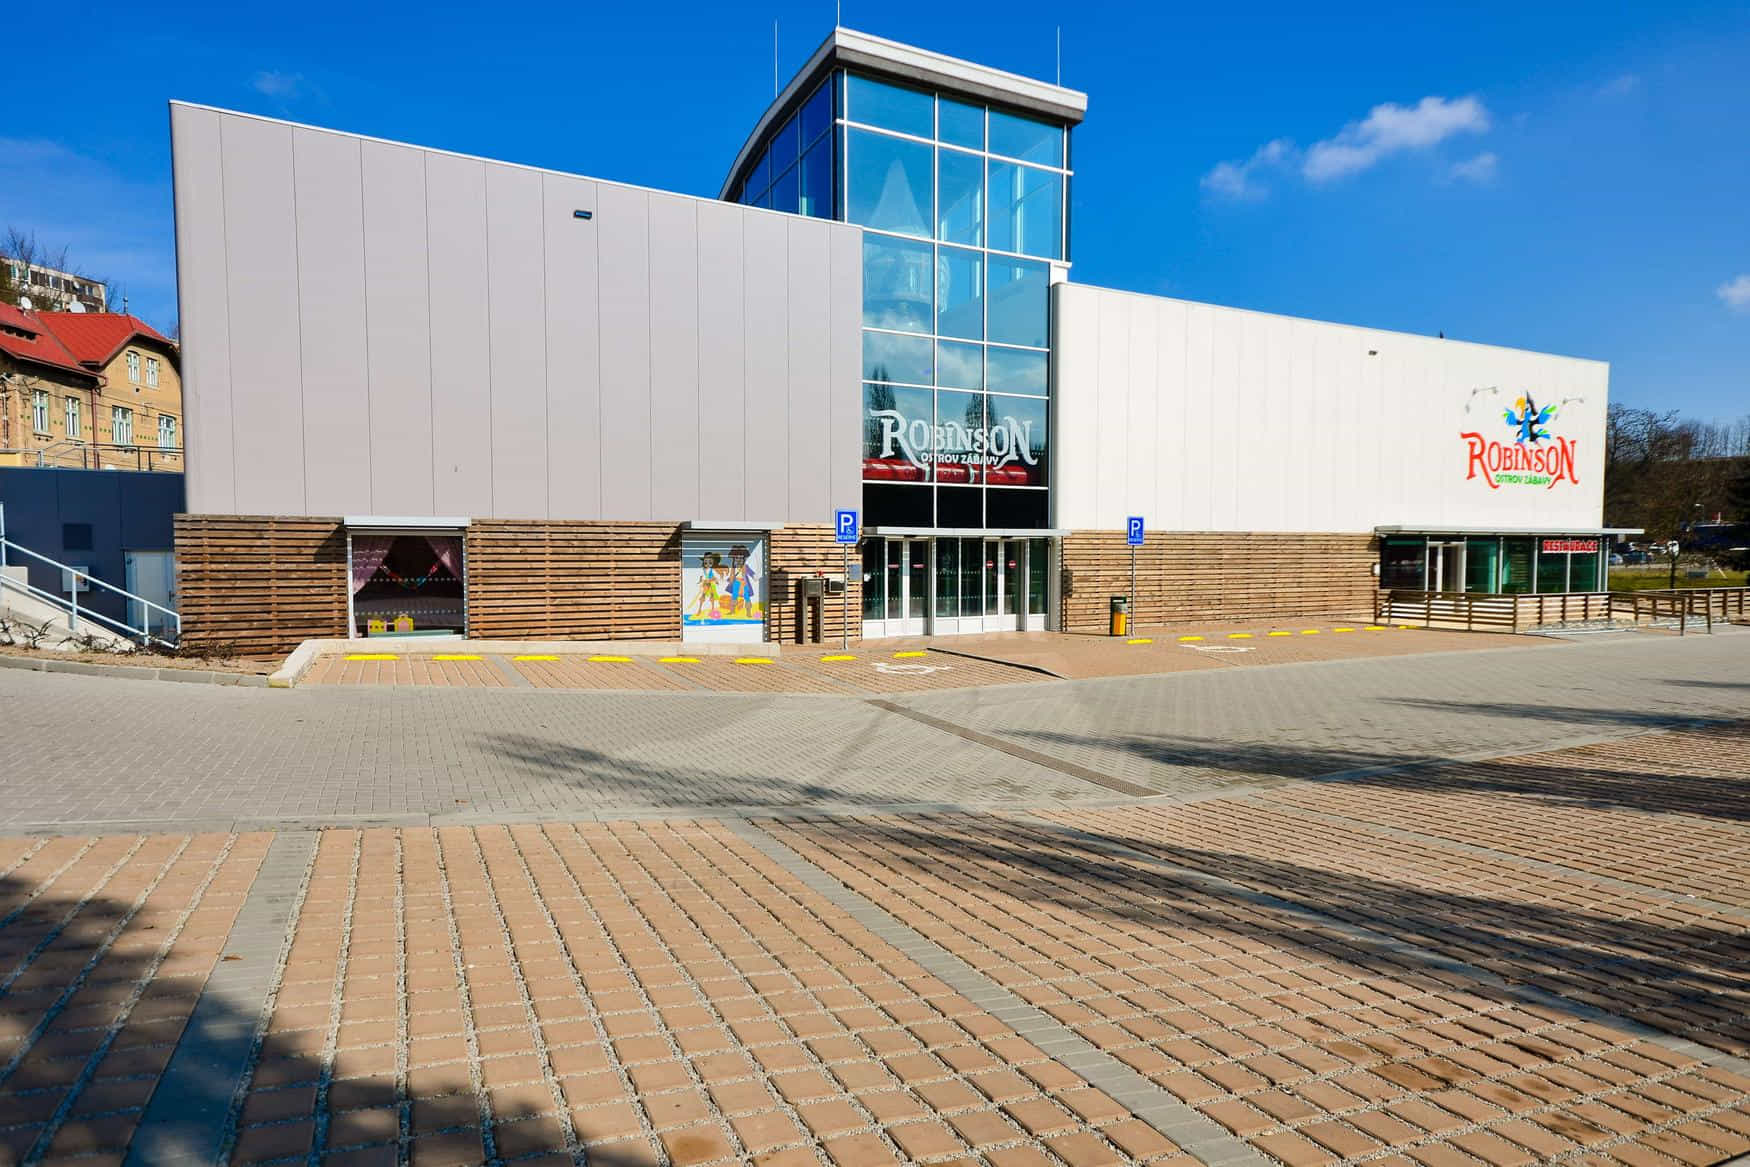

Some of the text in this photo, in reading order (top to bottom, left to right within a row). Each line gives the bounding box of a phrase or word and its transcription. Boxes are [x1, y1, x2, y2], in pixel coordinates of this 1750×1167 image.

[869, 408, 1038, 470] ROBINSON
[920, 452, 960, 465] OSROV
[1460, 432, 1579, 489] ROBINSON
[841, 514, 853, 533] P
[1131, 519, 1141, 537] P
